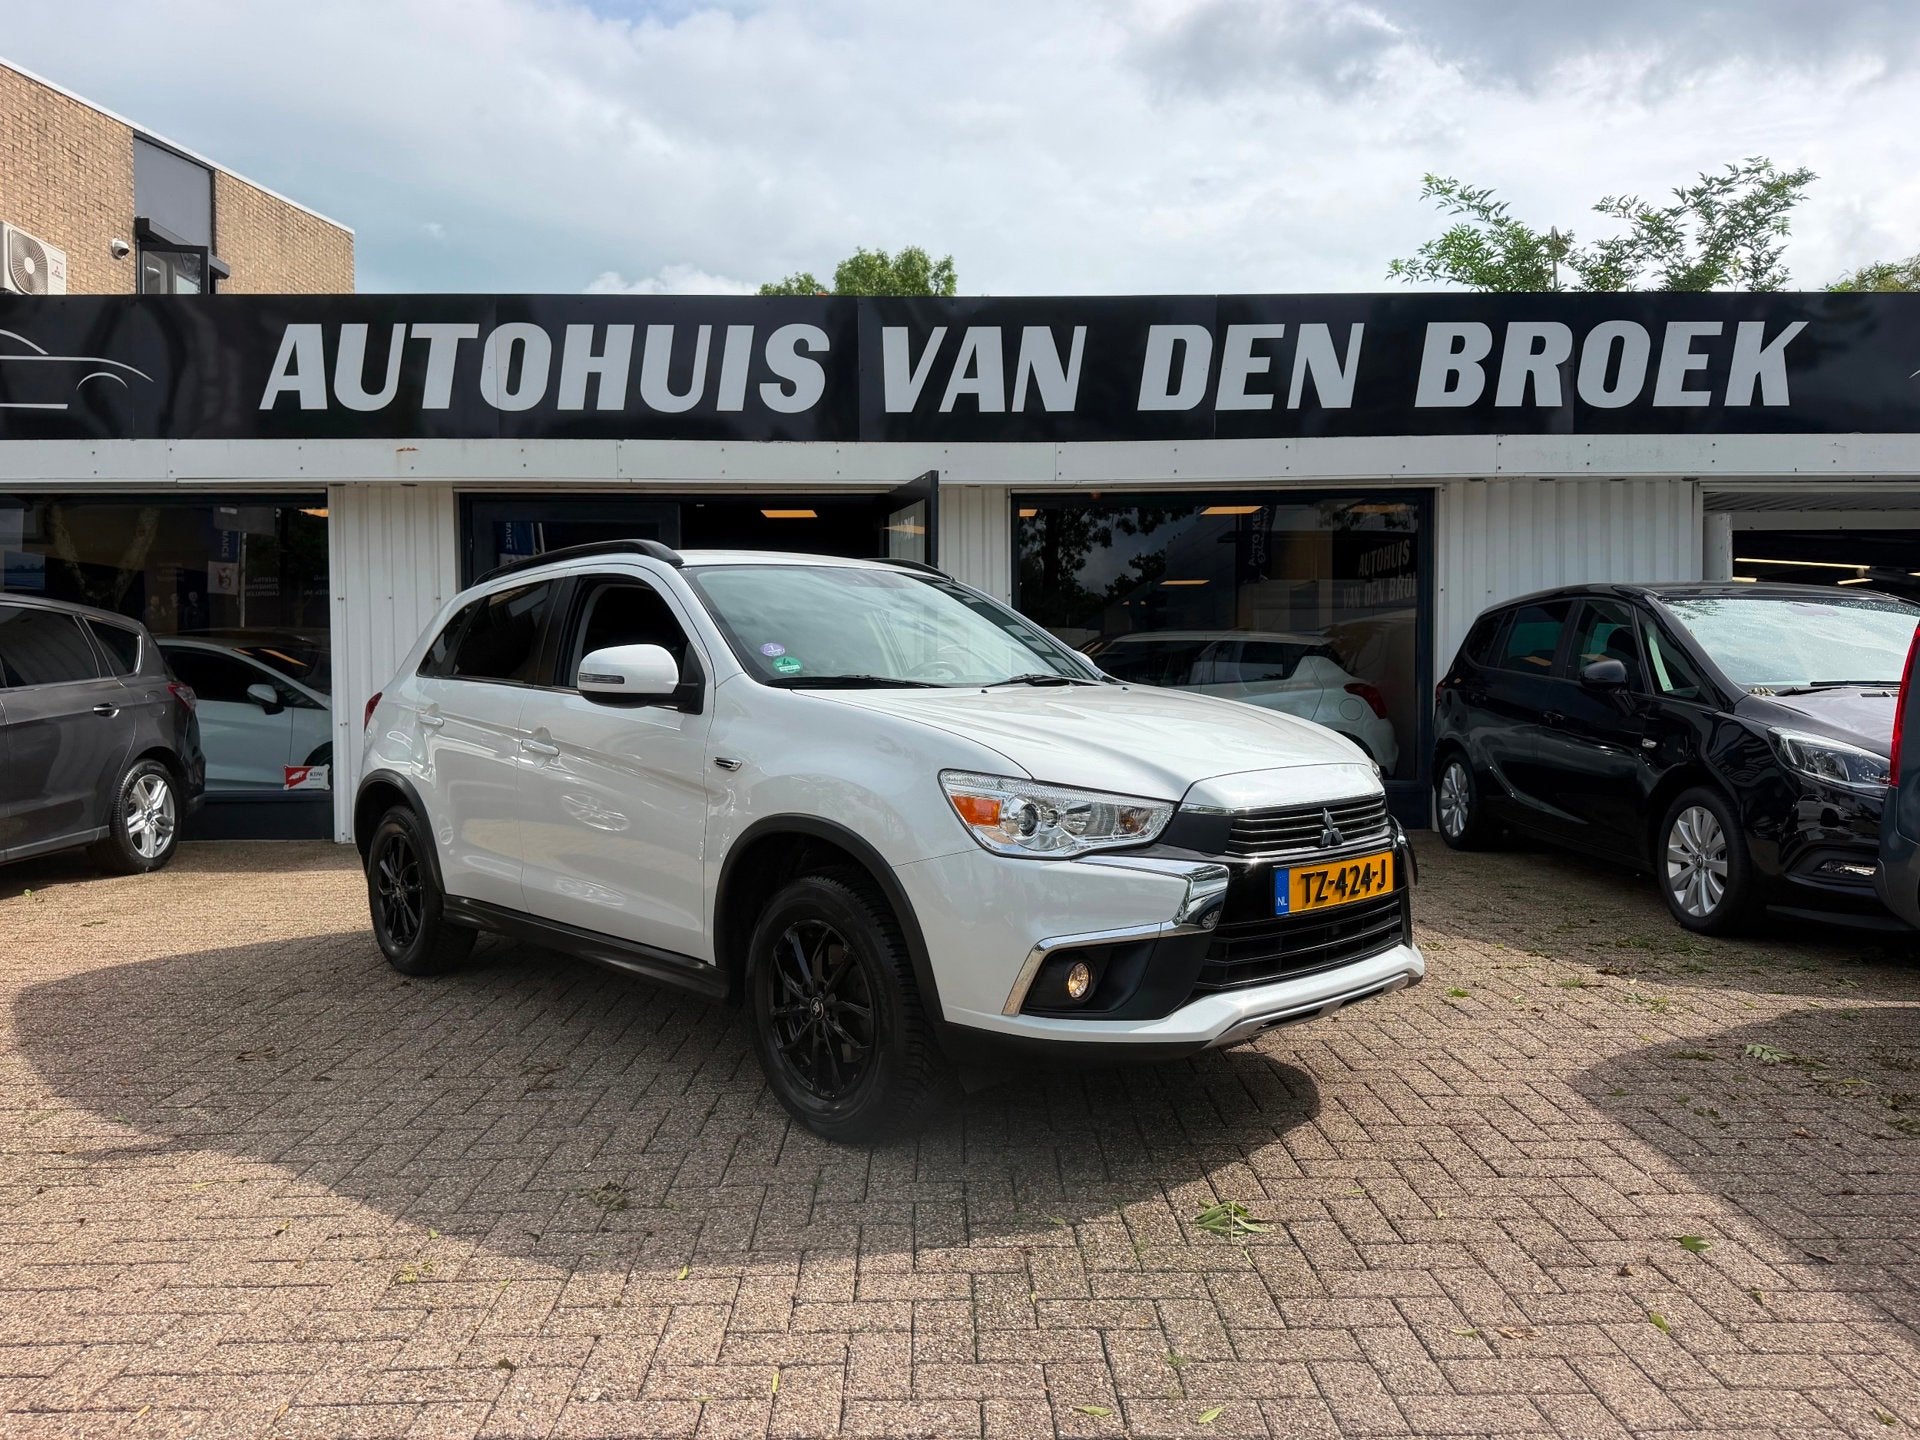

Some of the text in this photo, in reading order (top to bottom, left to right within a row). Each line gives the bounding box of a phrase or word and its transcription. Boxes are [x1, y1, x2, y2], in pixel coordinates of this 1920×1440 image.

[260, 320, 1808, 413] AUTOHUIS VAN DEN BROEK
[1358, 538, 1411, 577] AUTOHUIS
[1276, 896, 1288, 906] NL
[1300, 859, 1386, 904] TZ-424-J
